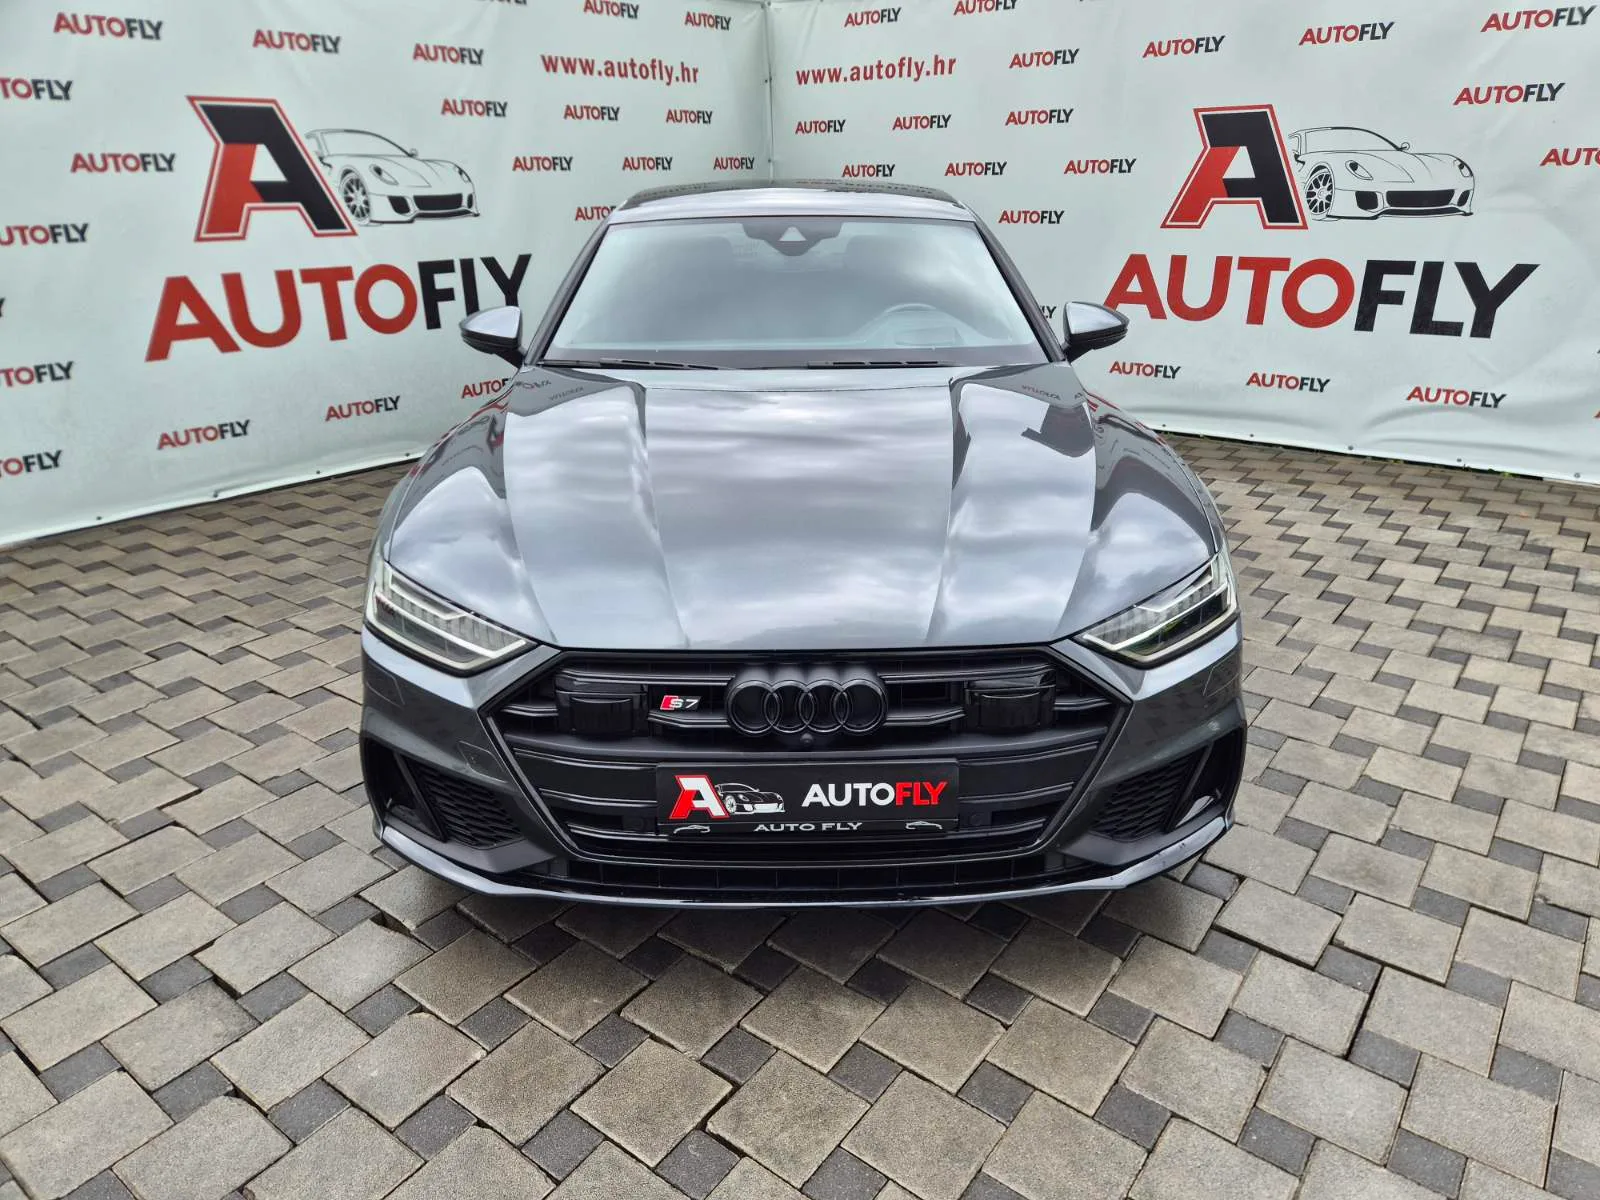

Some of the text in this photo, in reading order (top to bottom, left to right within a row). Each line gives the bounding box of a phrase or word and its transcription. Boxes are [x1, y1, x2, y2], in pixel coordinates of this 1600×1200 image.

[583, 0, 640, 20] AUTOFLY
[844, 7, 902, 28] AUTOFLY
[1480, 4, 1597, 33] AUTOFLY
[53, 12, 164, 41] AUTOFLY
[684, 11, 732, 31] AUTOFLY
[253, 29, 342, 54] AUTOFLY
[1299, 21, 1395, 46] AUTOFLY
[413, 43, 485, 66] AUTOFLY
[1142, 35, 1226, 59] AUTOFLY
[1009, 48, 1080, 69] AUTOFLY
[540, 54, 699, 86] www.autofly.hr
[796, 54, 957, 86] www.autofly.hr
[0, 77, 73, 101] TOFLY
[1453, 82, 1566, 106] AUTOFLY
[441, 98, 508, 118] AUTOFLY
[564, 104, 620, 122] AUTOFLY
[666, 109, 713, 125] AUTOFLY
[1005, 108, 1075, 127] AUTOFLY
[795, 119, 846, 135] AUTOFLY
[892, 114, 952, 131] AUTOFLY
[71, 153, 177, 174] AUTOFLY
[512, 156, 574, 172] AUTOFLY
[622, 156, 673, 172] AUTOFLY
[713, 156, 756, 171] AUTOFLY
[842, 164, 896, 179] AUTOFLY
[944, 161, 1008, 177] AUTOFLY
[1064, 158, 1137, 176] AUTOFLY
[575, 206, 616, 221] AUTO
[998, 210, 1065, 225] AUTOFLY
[0, 223, 89, 246] UTOFLY
[1103, 253, 1540, 339] AUTOFLY
[0, 361, 74, 388] TOFLY
[1109, 361, 1181, 380] AUTOFLY
[461, 378, 509, 399] AUTO
[1246, 372, 1330, 394] AUTOFLY
[1406, 386, 1507, 409] AUTOFLY
[325, 396, 400, 422] AUTOFLY
[157, 419, 251, 450] AUTOFLY
[801, 781, 948, 807] AUTOFLY
[753, 822, 863, 832] AUTO FLY
